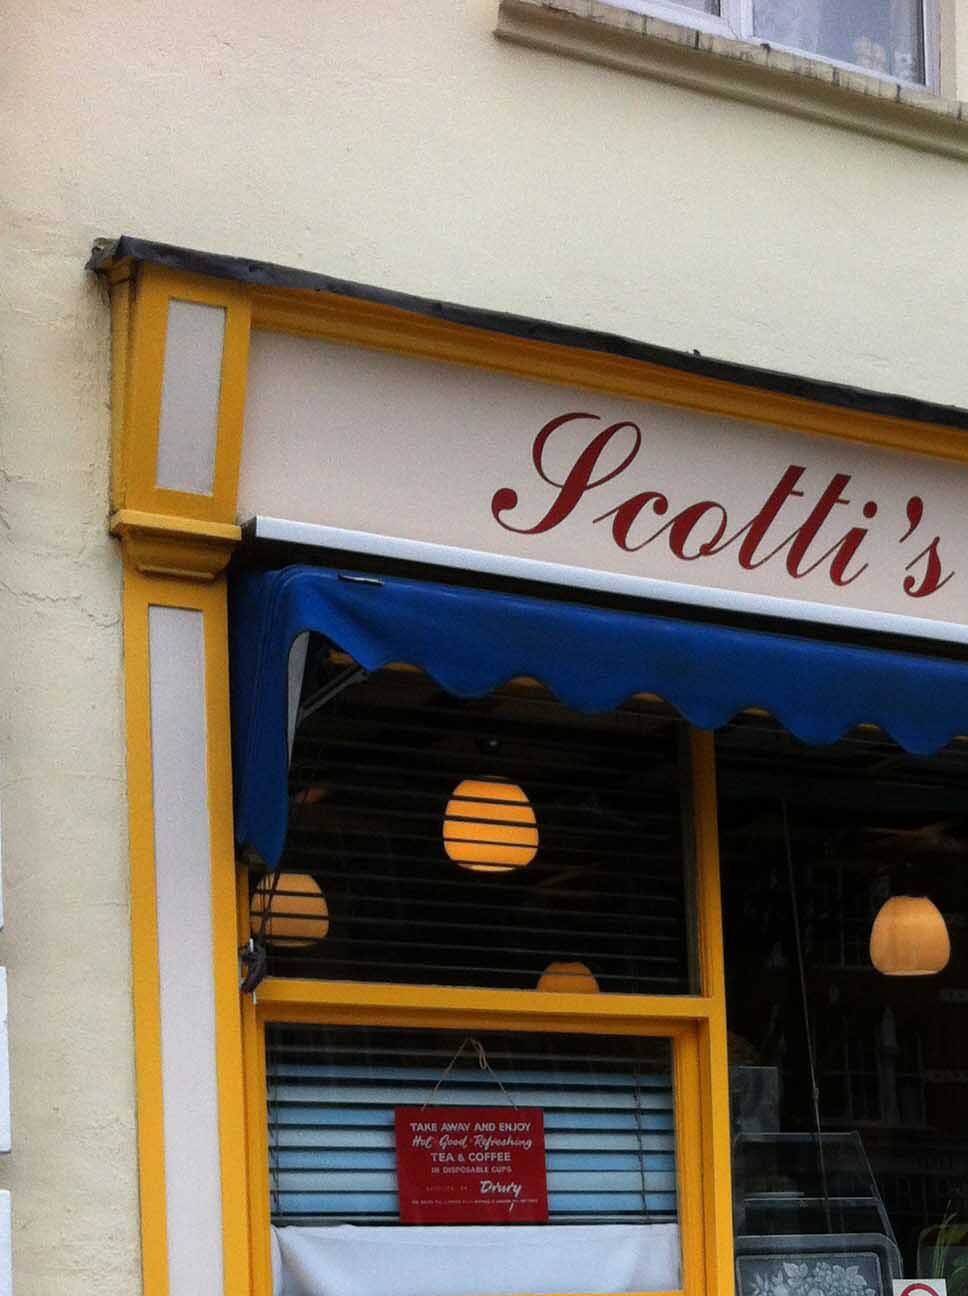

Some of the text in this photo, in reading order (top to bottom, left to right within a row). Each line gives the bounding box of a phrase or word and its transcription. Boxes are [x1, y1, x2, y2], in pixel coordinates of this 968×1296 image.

[491, 412, 955, 599] Scotti's
[410, 1122, 531, 1132] TAKE AWAY AND ENJOY
[412, 1134, 533, 1150] Hot Good Refreshing
[431, 1152, 511, 1162] TEA & COFFEE
[442, 1166, 488, 1174] DISPOSABLE
[491, 1166, 512, 1174] CUPS
[479, 1180, 522, 1199] Drury
